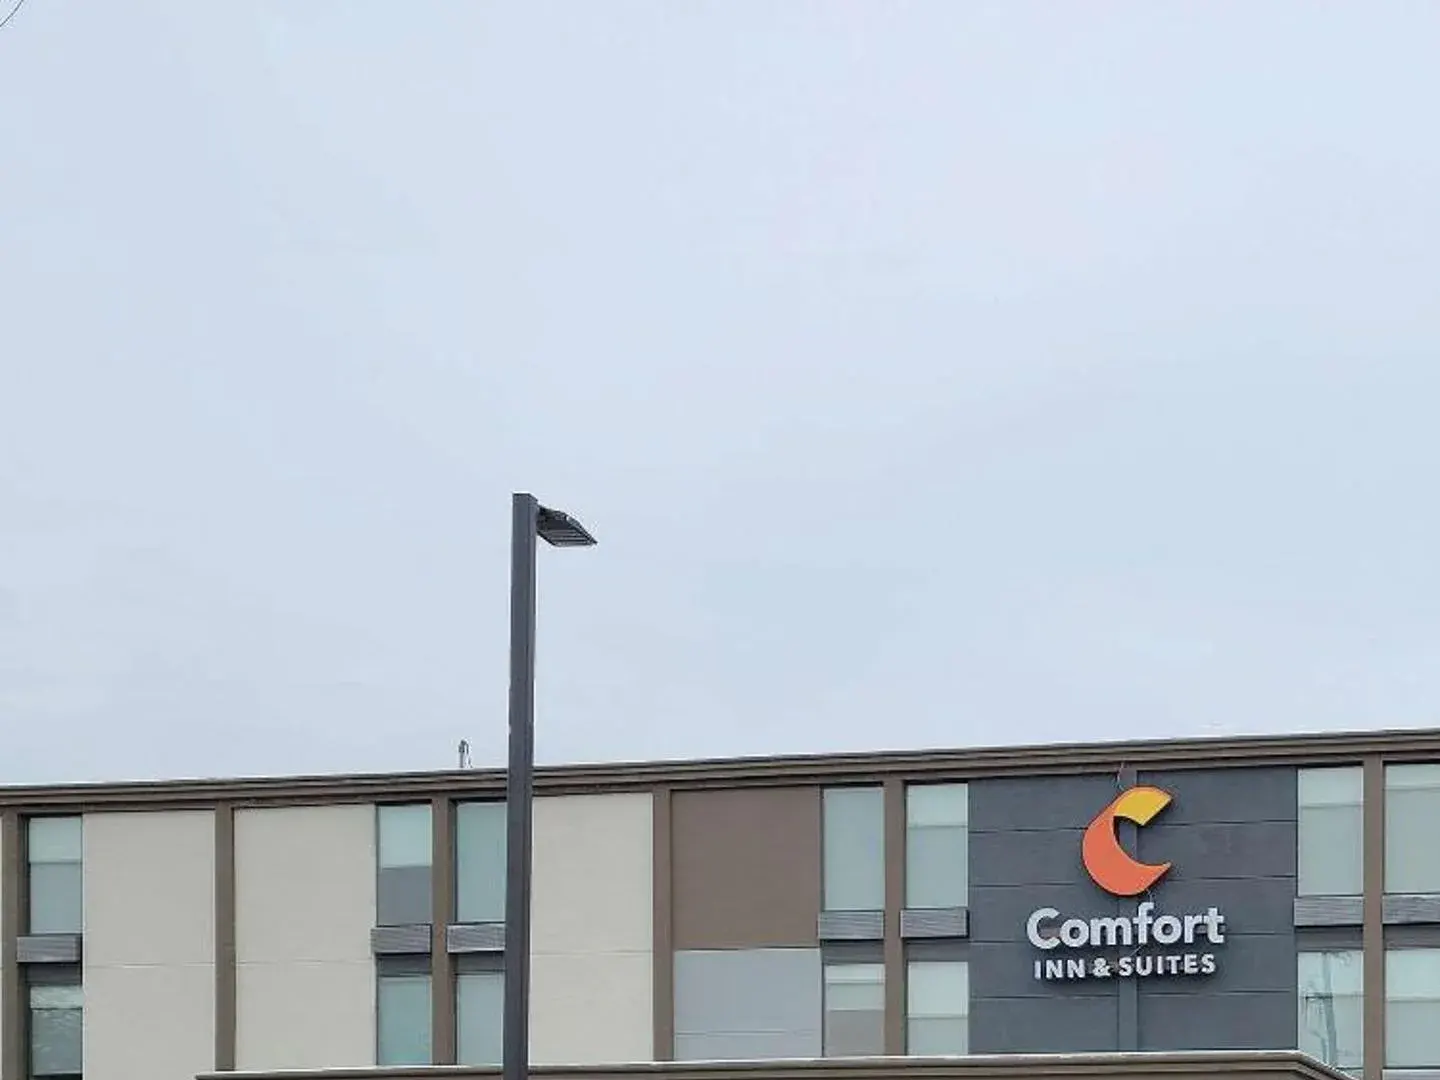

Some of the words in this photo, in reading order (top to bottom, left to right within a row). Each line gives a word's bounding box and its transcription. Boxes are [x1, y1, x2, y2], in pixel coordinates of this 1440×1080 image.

[1026, 902, 1225, 949] Comfort
[1034, 958, 1087, 979] INN
[1092, 956, 1111, 977] &
[1118, 953, 1217, 977] SUITES
